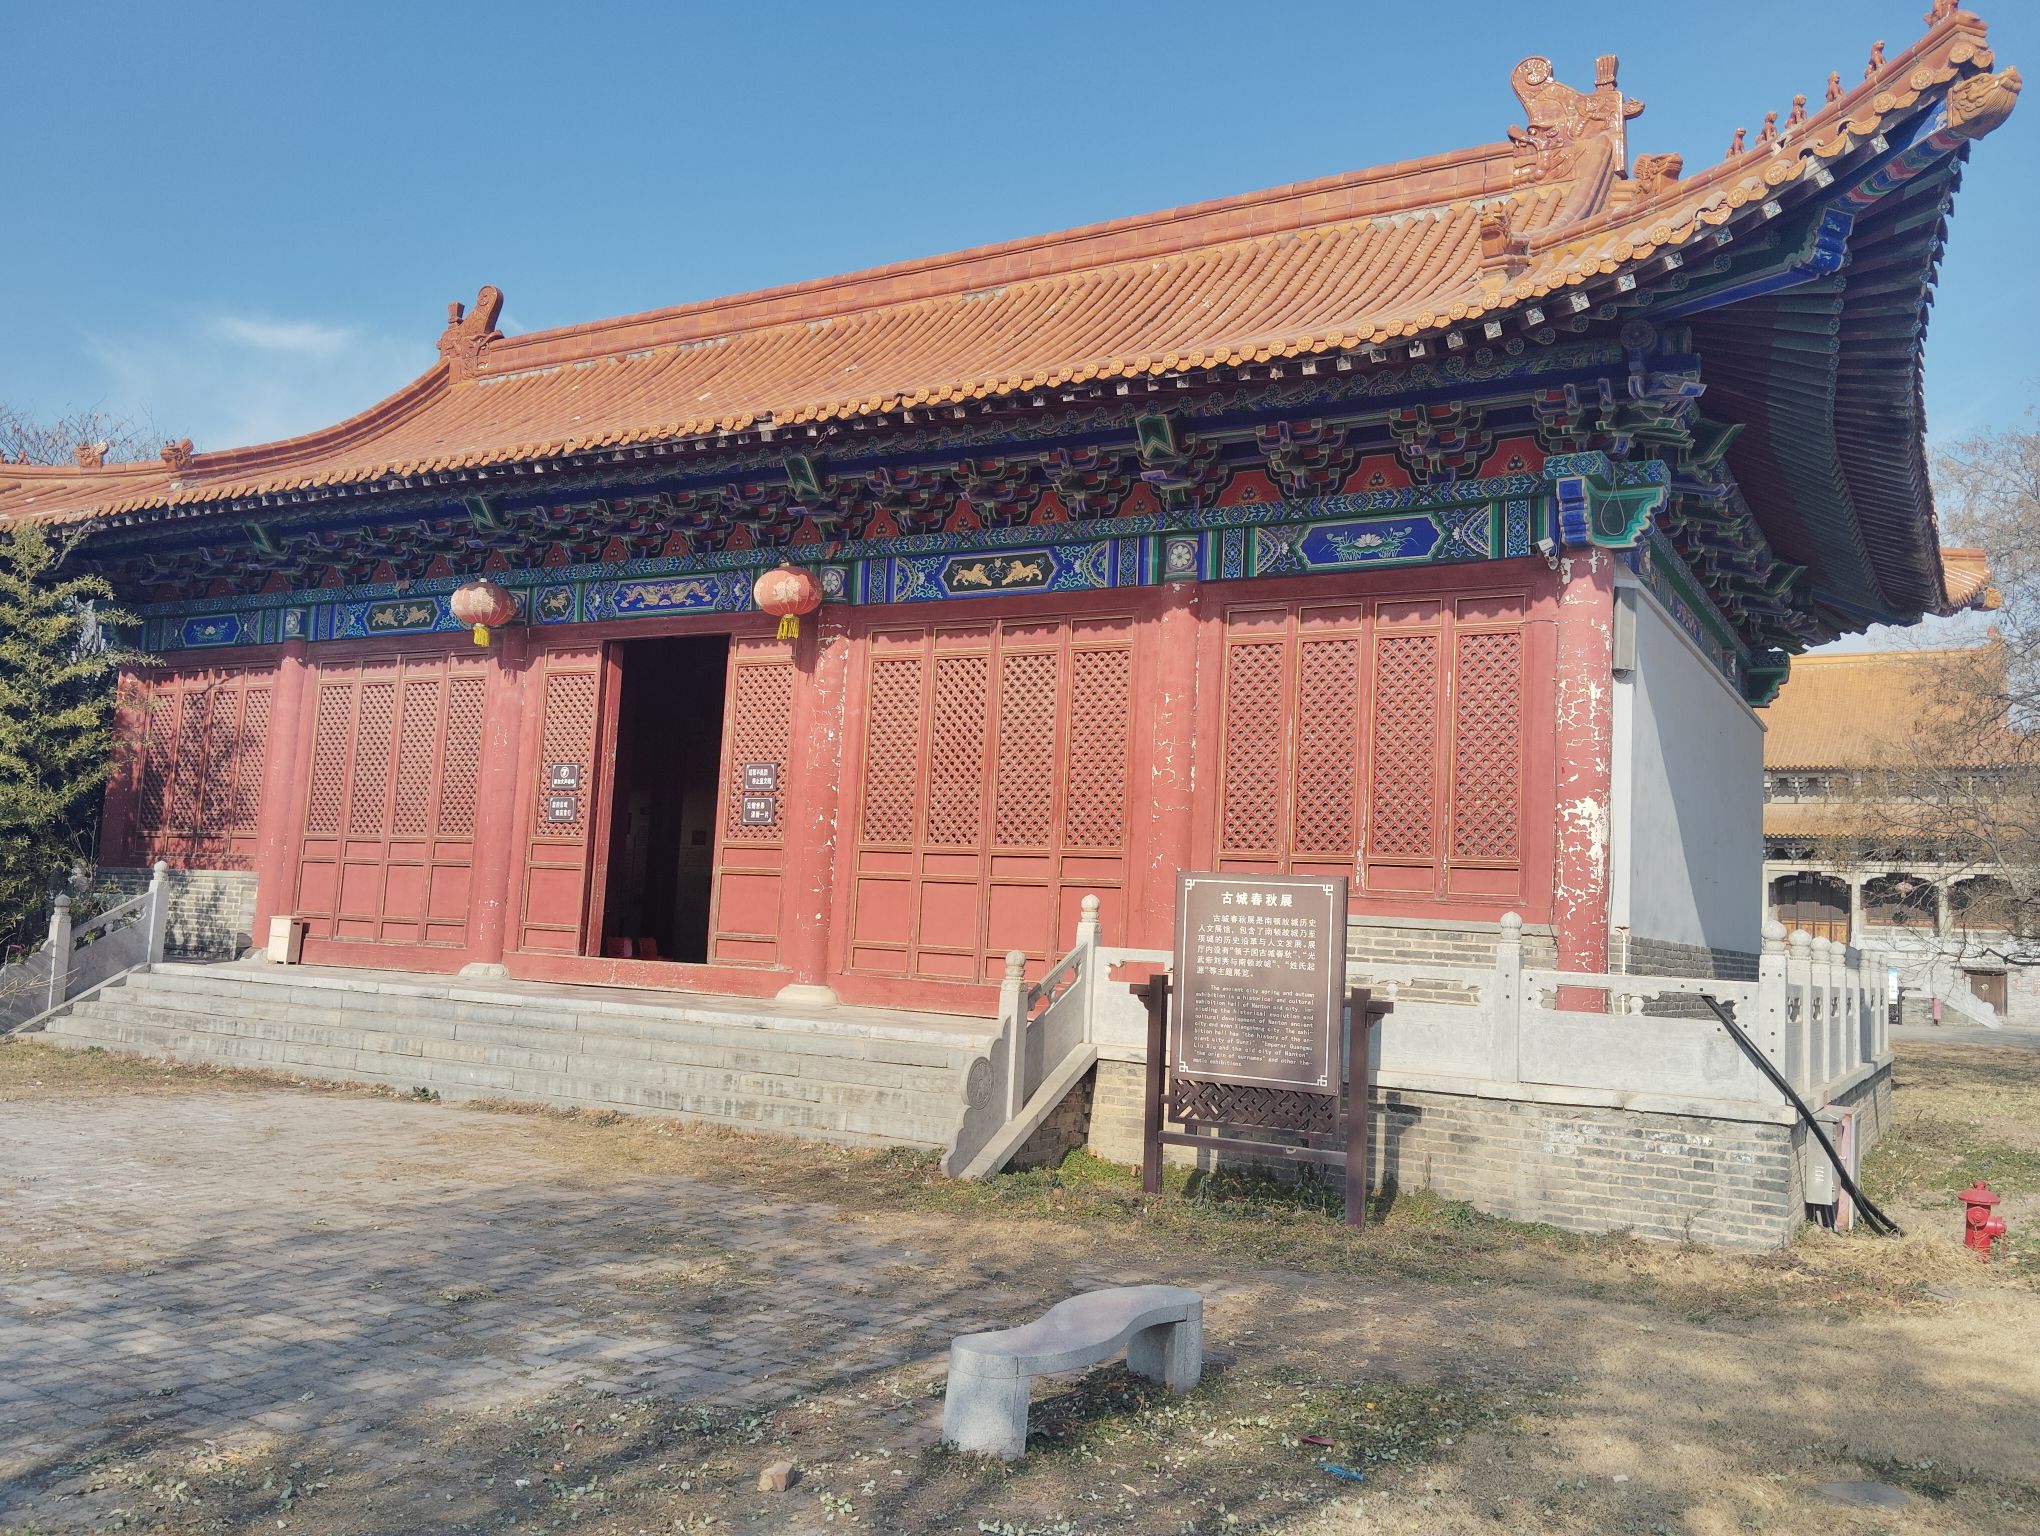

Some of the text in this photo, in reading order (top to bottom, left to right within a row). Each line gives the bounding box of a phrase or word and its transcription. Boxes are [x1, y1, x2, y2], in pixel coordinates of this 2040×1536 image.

[1221, 891, 1293, 908] 古城春秋展
[1213, 914, 1317, 927] 古城春秋展是南顿故城历史
